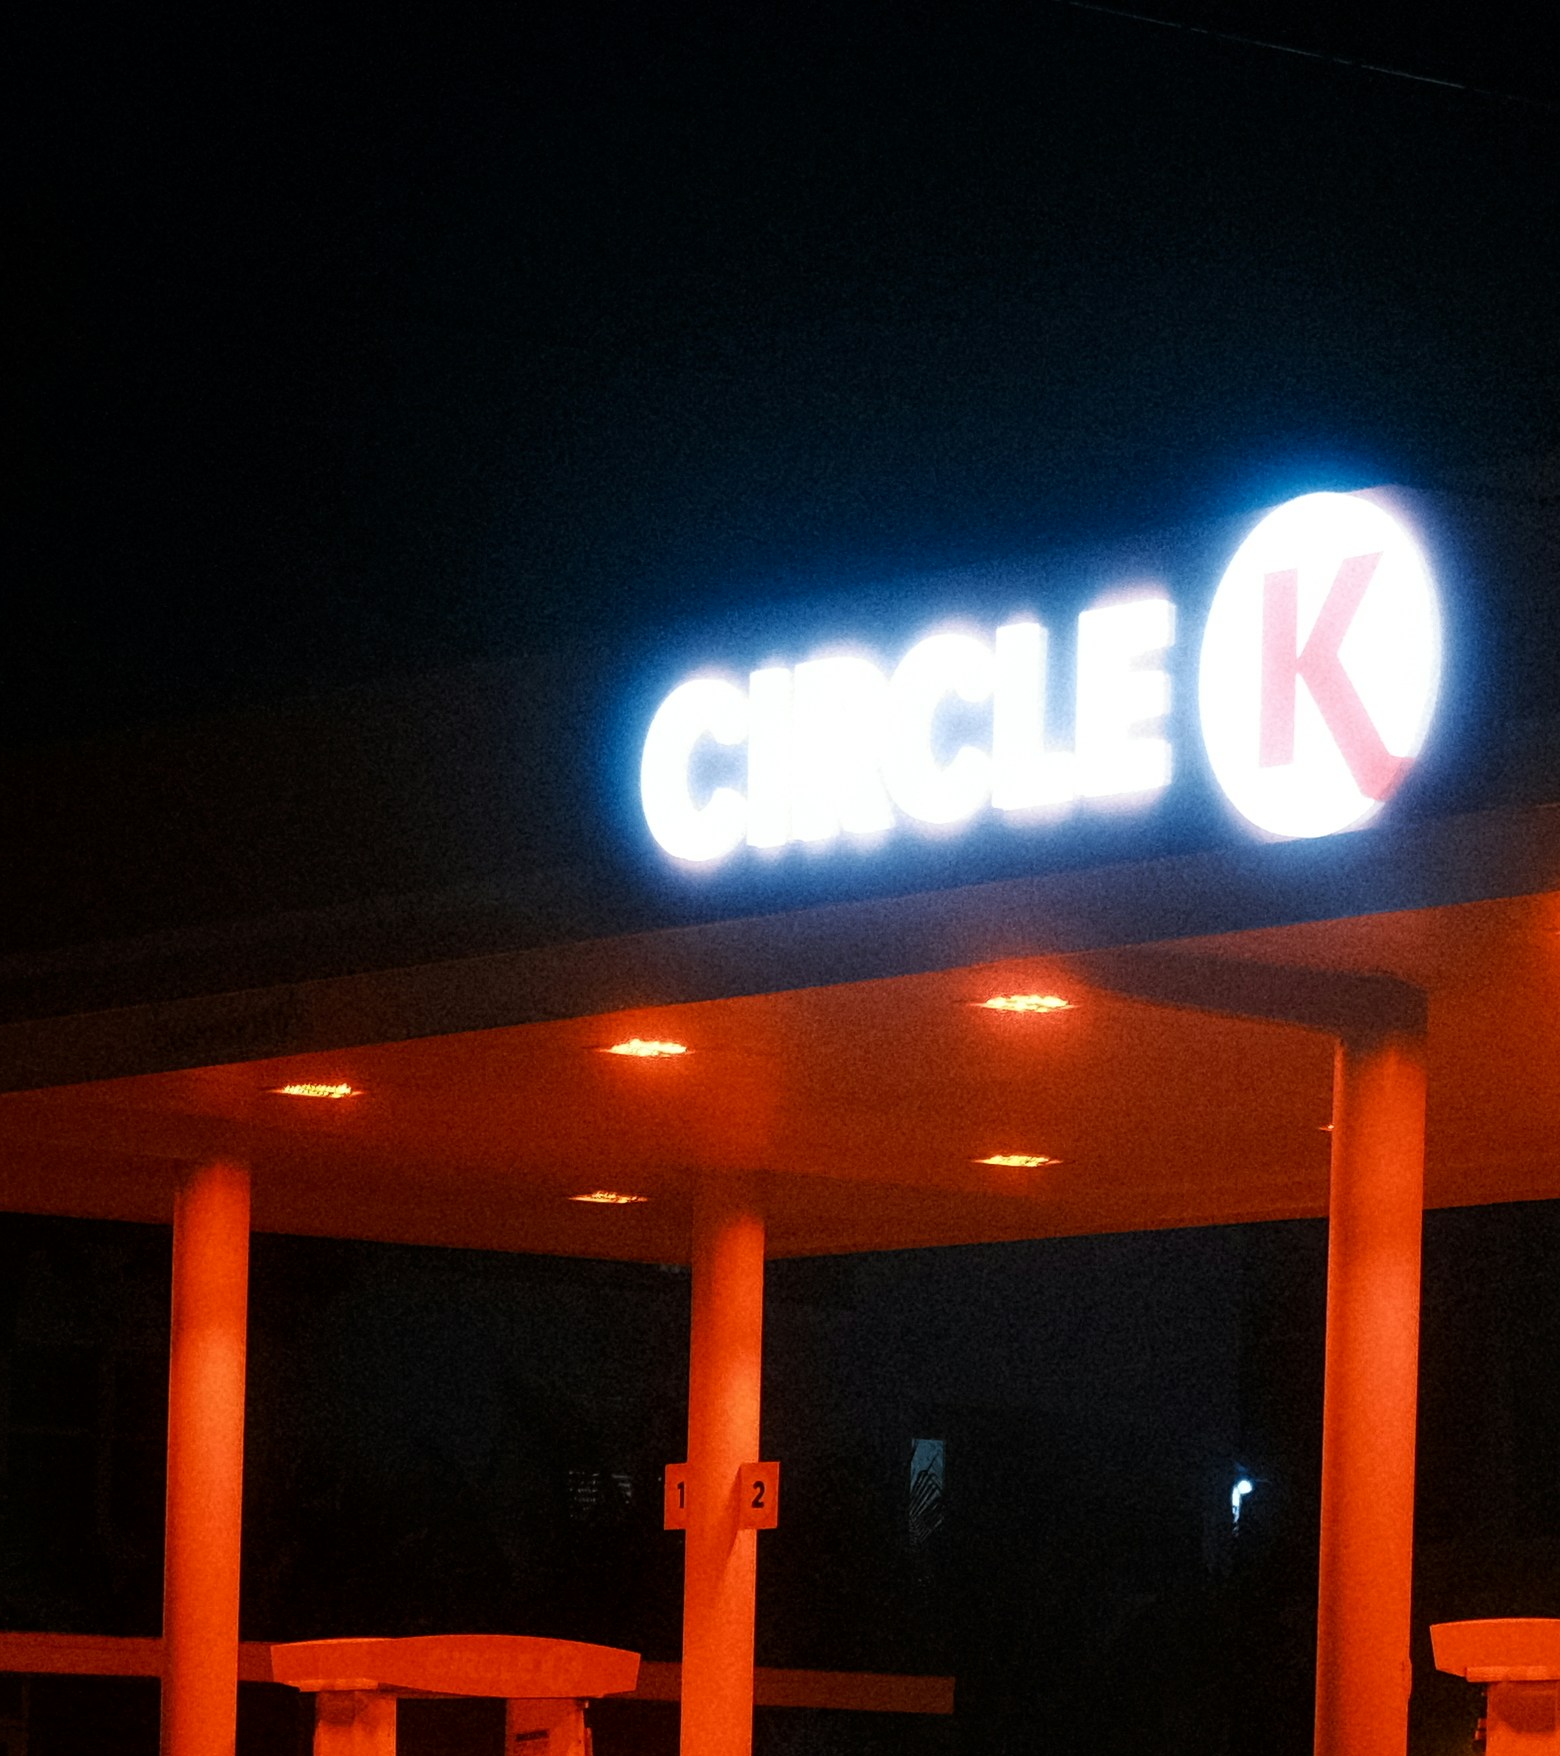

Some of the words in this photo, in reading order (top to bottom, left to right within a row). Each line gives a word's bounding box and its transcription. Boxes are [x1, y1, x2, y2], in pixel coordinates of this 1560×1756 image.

[640, 598, 1178, 862] CIRCLE
[1257, 551, 1420, 801] K
[676, 1480, 686, 1509] 1
[751, 1480, 766, 1509] 2
